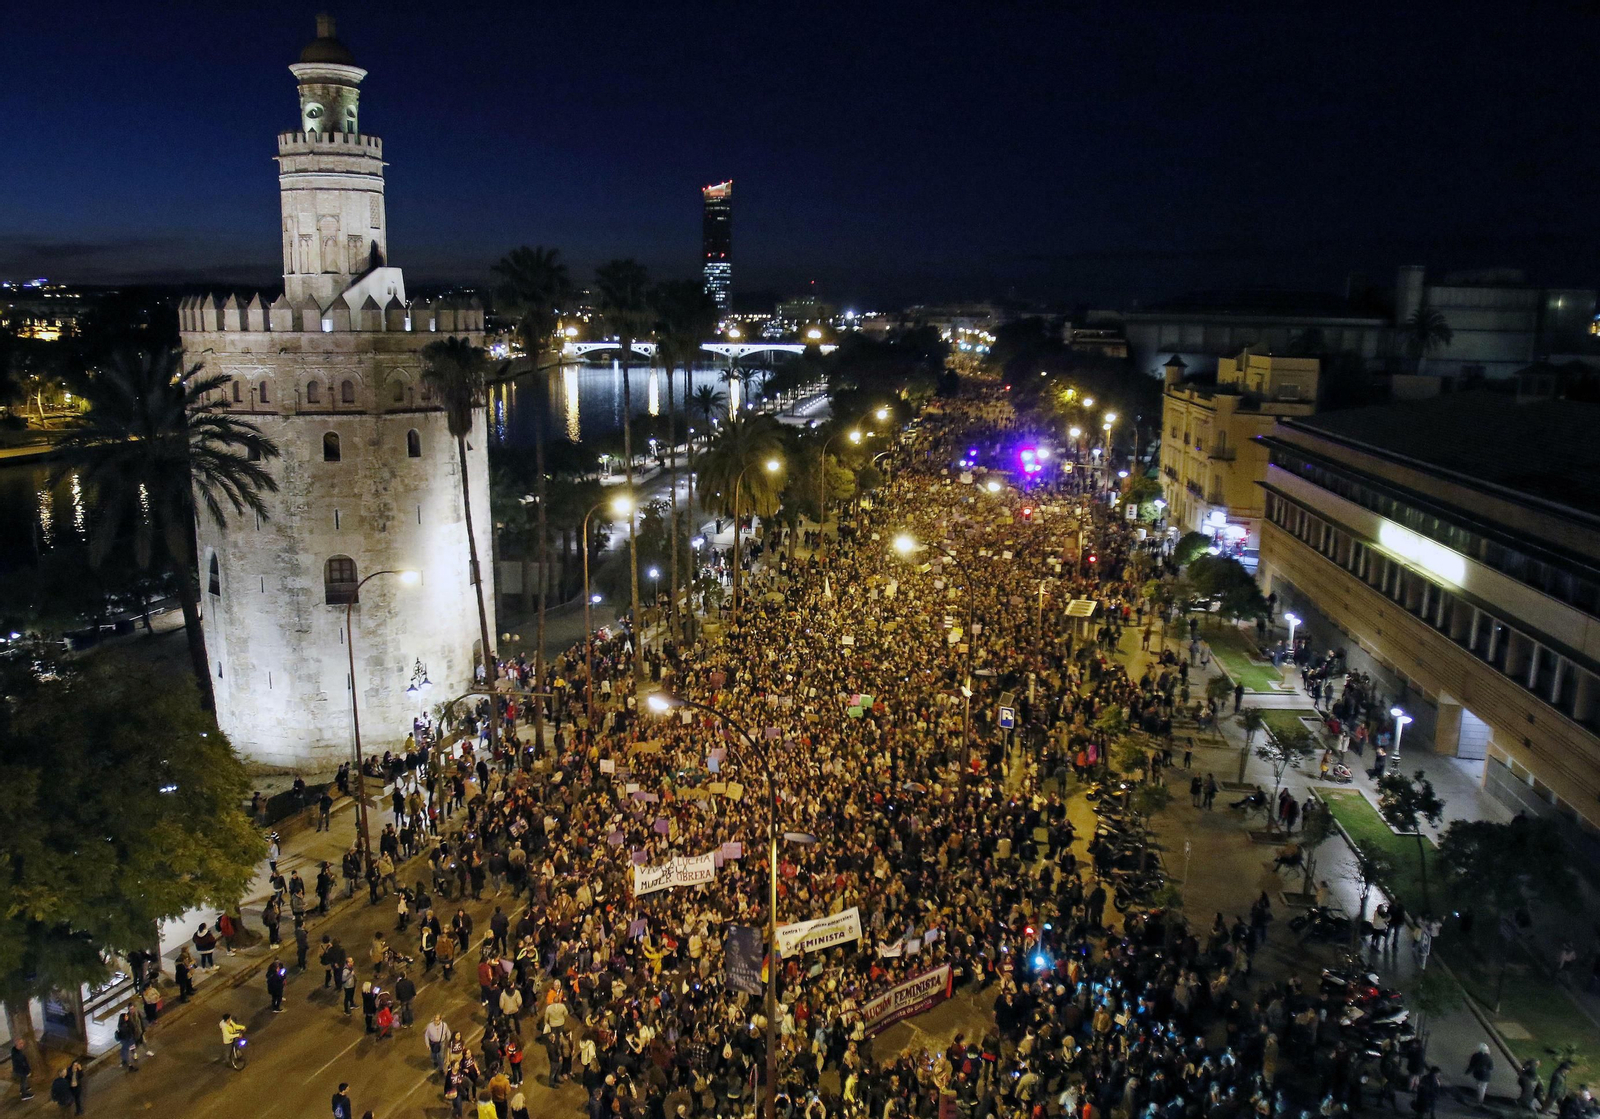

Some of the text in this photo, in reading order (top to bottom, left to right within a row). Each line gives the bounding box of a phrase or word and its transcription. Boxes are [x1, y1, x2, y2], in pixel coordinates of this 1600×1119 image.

[640, 866, 662, 874] VIV
[677, 854, 711, 866] LUCHA
[640, 869, 712, 890] MUJER OBRERA
[794, 931, 845, 951] FEMINISTA
[894, 974, 942, 1002] FEMINISTA
